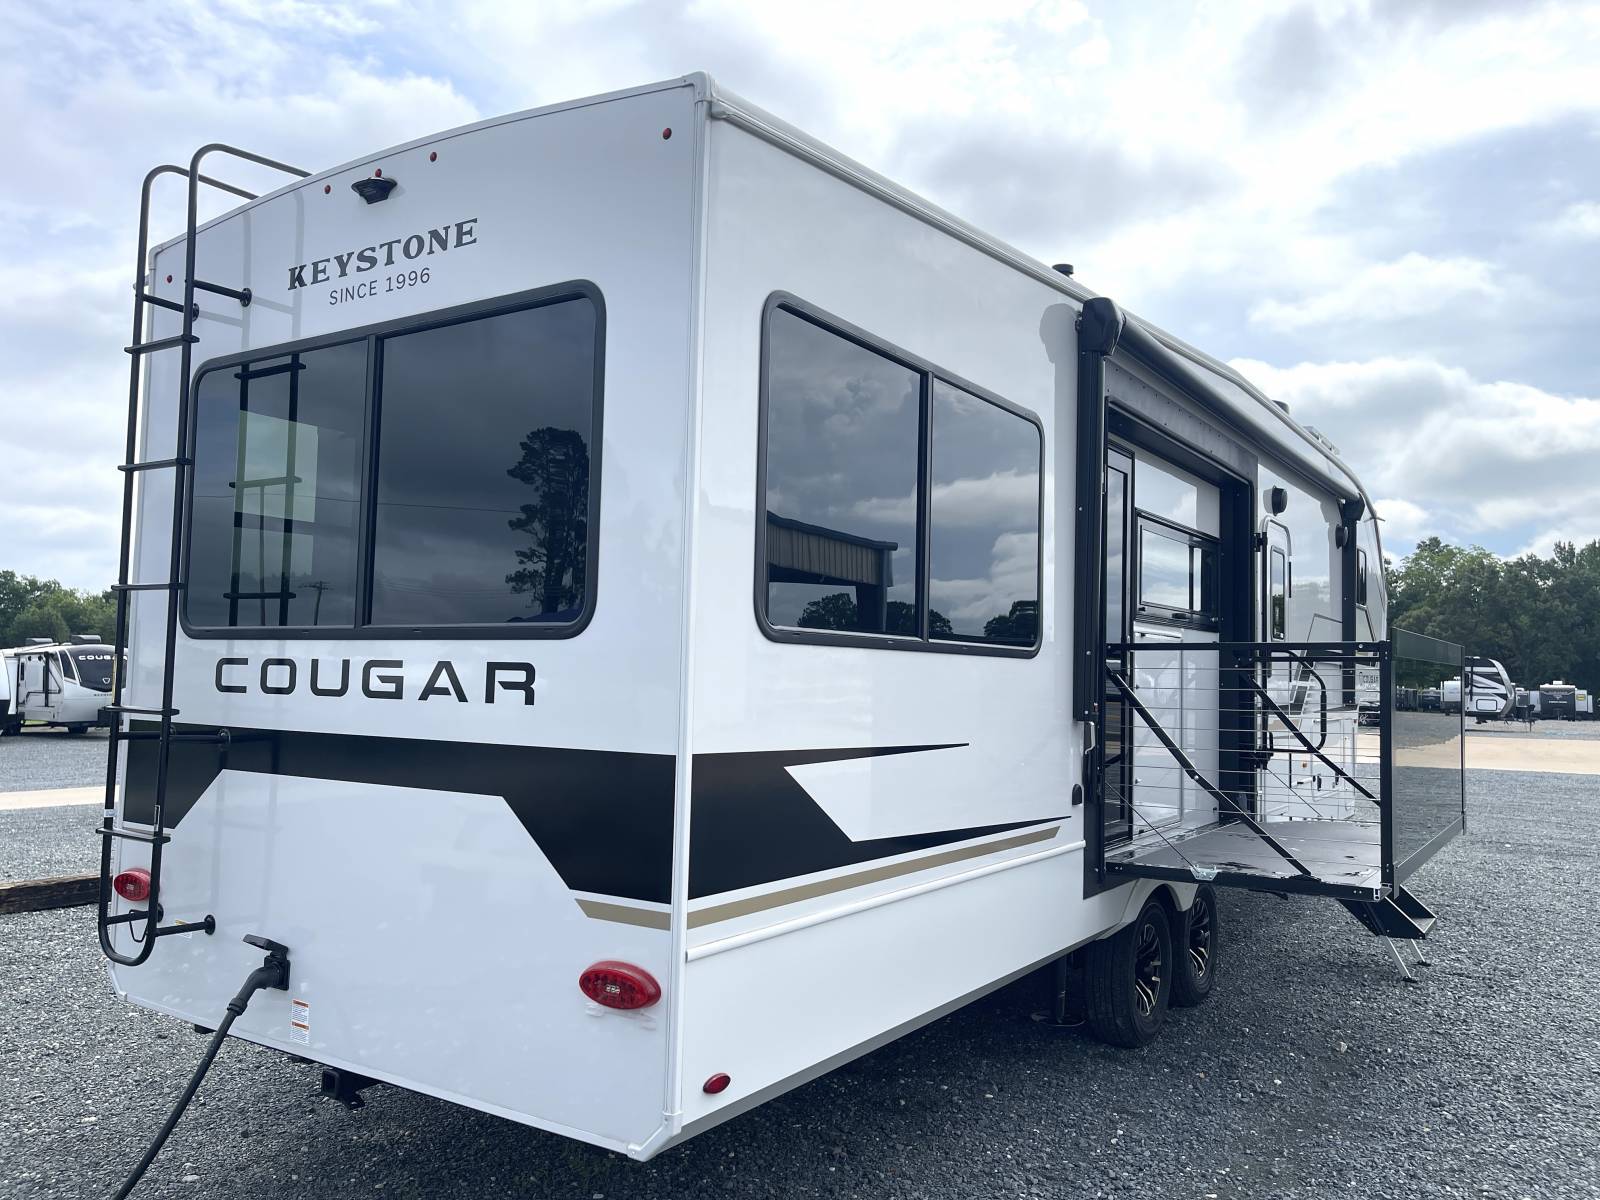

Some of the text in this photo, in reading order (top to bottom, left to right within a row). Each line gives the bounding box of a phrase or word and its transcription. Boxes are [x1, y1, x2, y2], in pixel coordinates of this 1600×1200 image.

[287, 217, 478, 291] KEYSTONE
[329, 267, 430, 306] SINCE 1996
[215, 657, 536, 706] COUGAR
